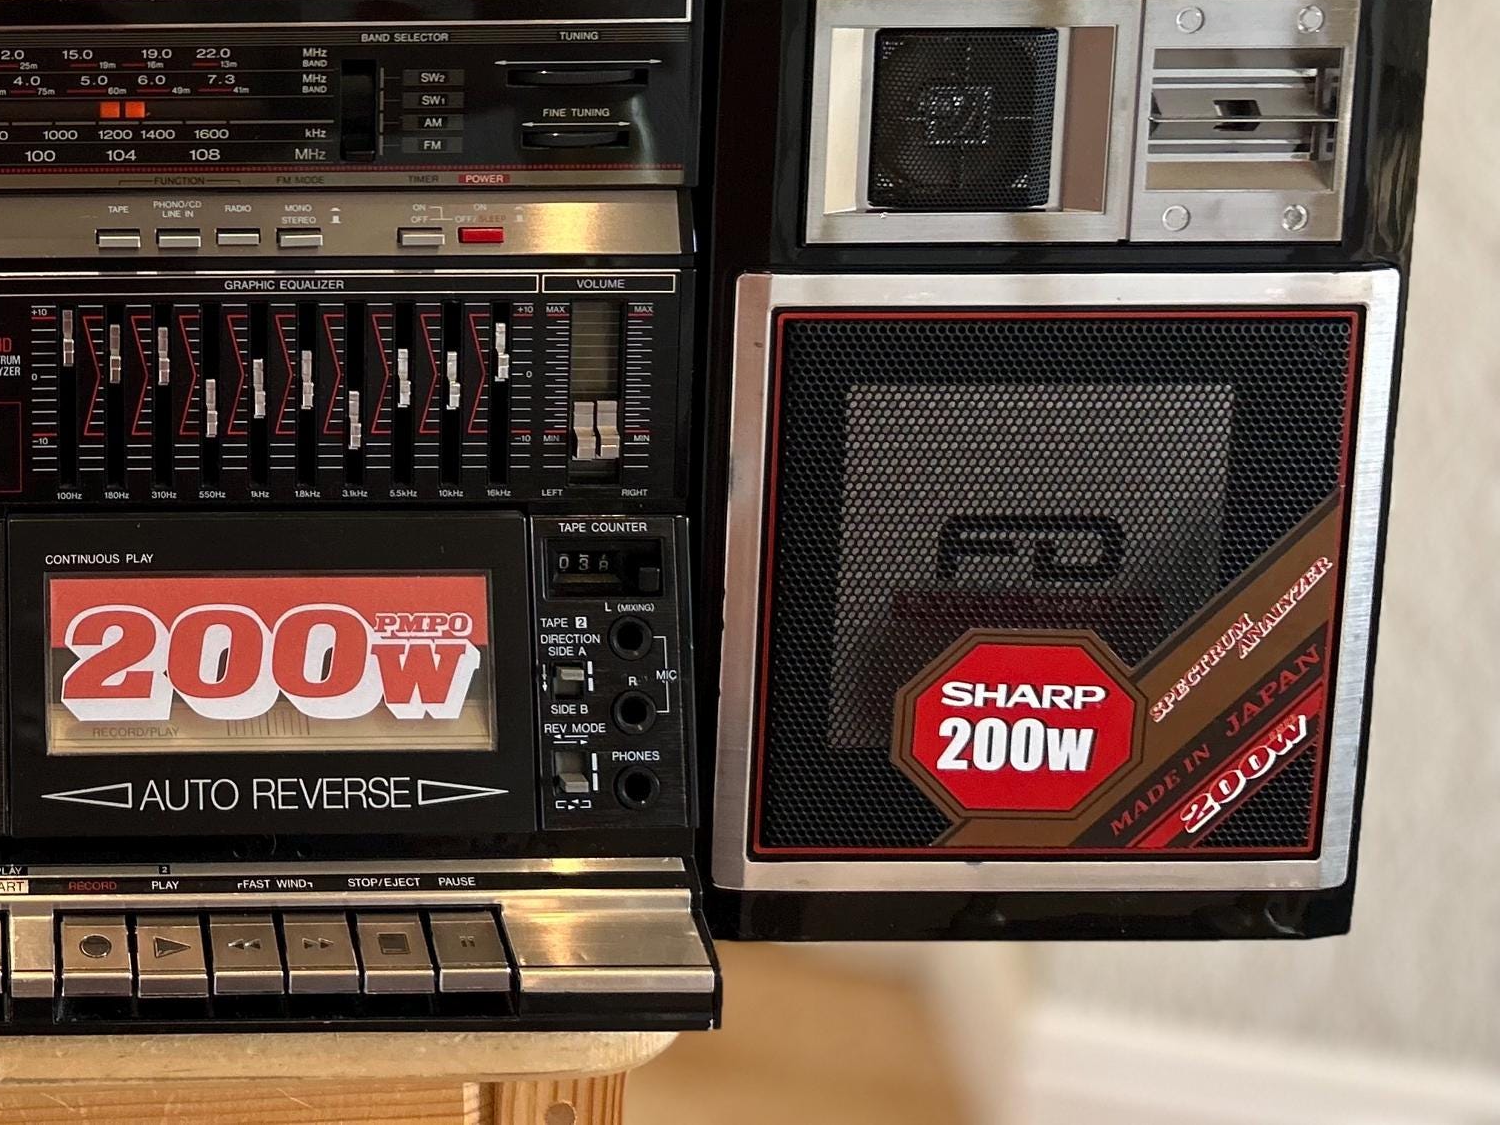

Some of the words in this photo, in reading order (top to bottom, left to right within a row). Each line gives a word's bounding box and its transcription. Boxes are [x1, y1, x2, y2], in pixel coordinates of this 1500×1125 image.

[361, 33, 390, 43] BAND
[393, 32, 449, 42] SELECTOR
[559, 31, 599, 41] TUNING
[62, 49, 93, 60] 15.0
[141, 48, 173, 59] 19.0
[196, 47, 231, 59] 22.0
[302, 47, 328, 57] MHz
[542, 108, 568, 117] FINE
[571, 107, 610, 117] TUNING
[423, 118, 443, 128] AM
[423, 140, 442, 150] FM
[24, 150, 56, 162] 100
[106, 149, 137, 162] 104
[189, 148, 221, 161] 108
[294, 148, 326, 161] MHz
[153, 176, 206, 186] FUNCTION
[465, 174, 504, 184] POWER
[107, 205, 130, 214] TAPE
[153, 200, 202, 209] PHONO/CD
[224, 204, 252, 213] RADIO
[162, 210, 181, 218] LINE
[184, 209, 194, 218] IN
[281, 216, 317, 225] STEREO
[224, 279, 276, 291] GRAPHIC
[279, 278, 345, 290] EQUALIZER
[576, 278, 625, 289] VOLUME
[56, 491, 82, 501] 100Hz
[104, 491, 130, 501] 180Hz
[151, 490, 177, 500] 310Hz
[198, 490, 226, 500] 550Hz
[389, 489, 418, 499] 5.5kHz
[438, 489, 464, 499] 10kHz
[486, 488, 512, 498] 16kHz
[541, 488, 563, 497] LEFT
[621, 487, 649, 497] RIGHT
[558, 522, 587, 532] TAPE
[591, 522, 647, 532] COUNTER
[45, 554, 120, 565] CONTINUOUS
[126, 552, 154, 564] PLAY
[617, 602, 654, 613] (MIXING)
[1236, 556, 1334, 659] ANALYZER
[374, 612, 472, 637] PMPO
[540, 618, 569, 628] TAPE
[540, 633, 600, 644] DIRECTION
[548, 646, 575, 656] SIDE
[578, 646, 587, 656] A
[1149, 613, 1253, 723] SPECTRUM
[656, 670, 677, 680] MIC
[941, 682, 1106, 709] SHARP
[92, 726, 180, 738] RECORD/PLAY
[1110, 769, 1182, 836] MADE
[1183, 743, 1212, 772] IN
[1225, 644, 1321, 737] JAPAN
[612, 751, 660, 761] PHONES
[1179, 714, 1307, 834] 200W
[139, 779, 239, 811] AUTO
[252, 777, 411, 810] REVERSE
[68, 881, 117, 891] RECORD
[151, 880, 180, 890] PLAY
[242, 879, 271, 889] FAST
[276, 878, 308, 888] WIND
[347, 877, 421, 888] STOP/EJECT
[438, 876, 476, 887] PAUSE
